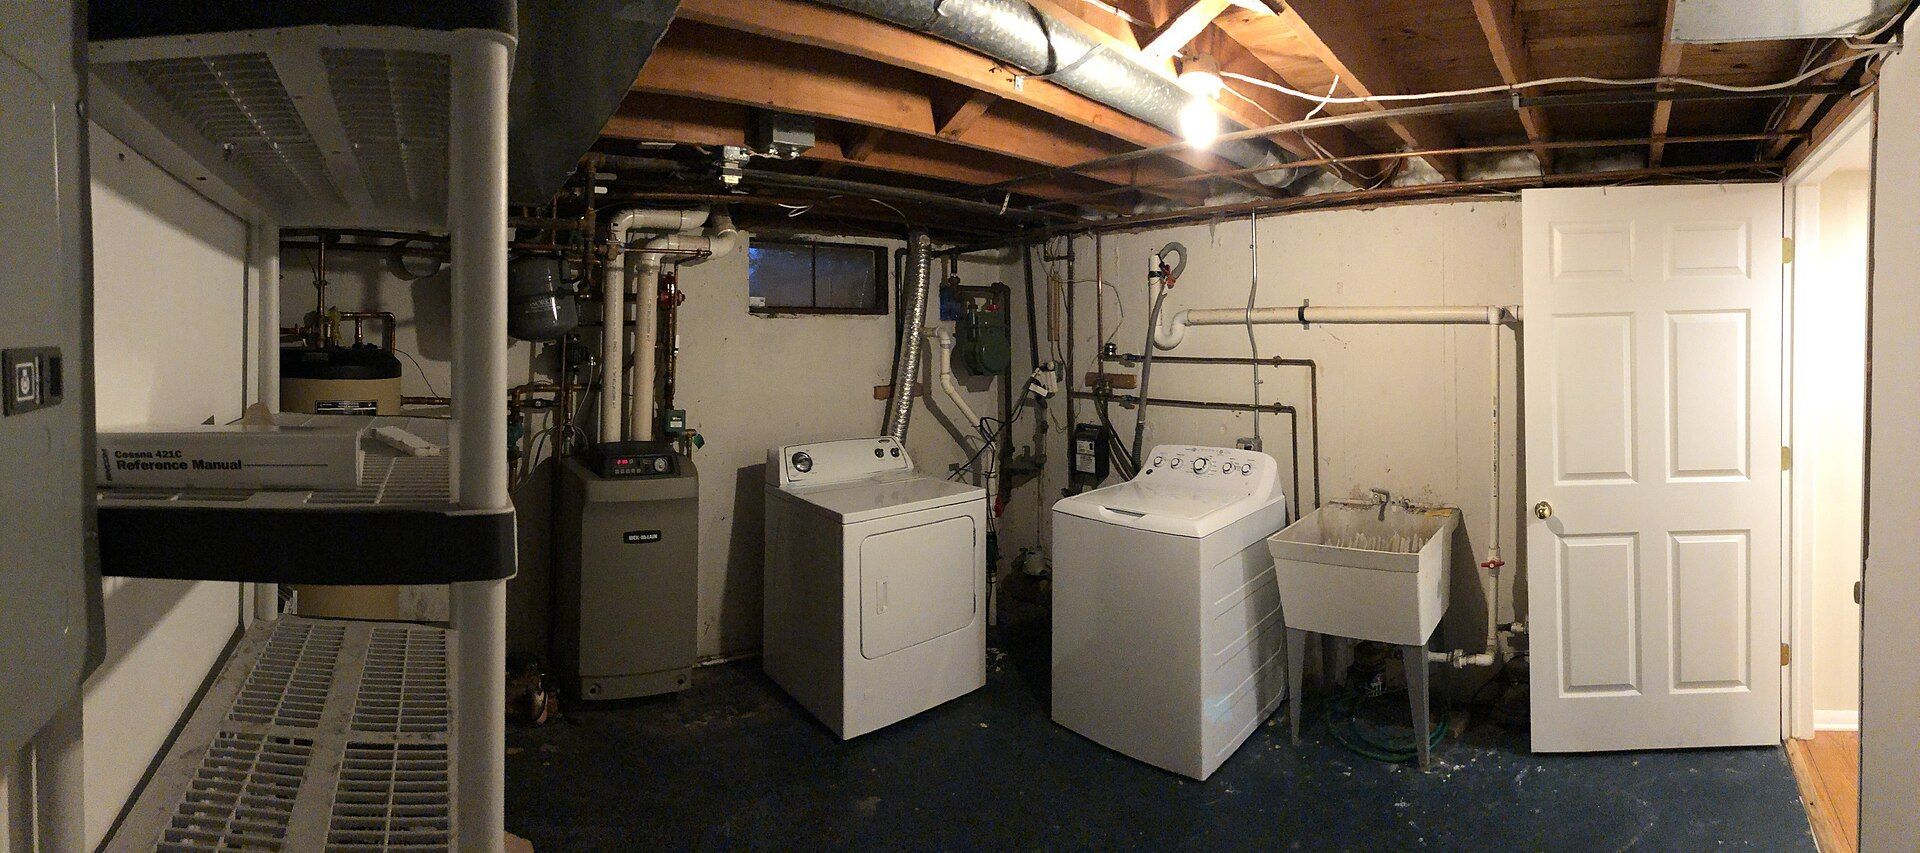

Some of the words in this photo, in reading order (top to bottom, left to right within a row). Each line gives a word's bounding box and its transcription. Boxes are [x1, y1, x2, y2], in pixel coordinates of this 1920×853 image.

[114, 450, 153, 459] Cessna
[155, 450, 182, 459] 421C
[116, 459, 188, 471] Reference
[191, 459, 242, 470] Manual
